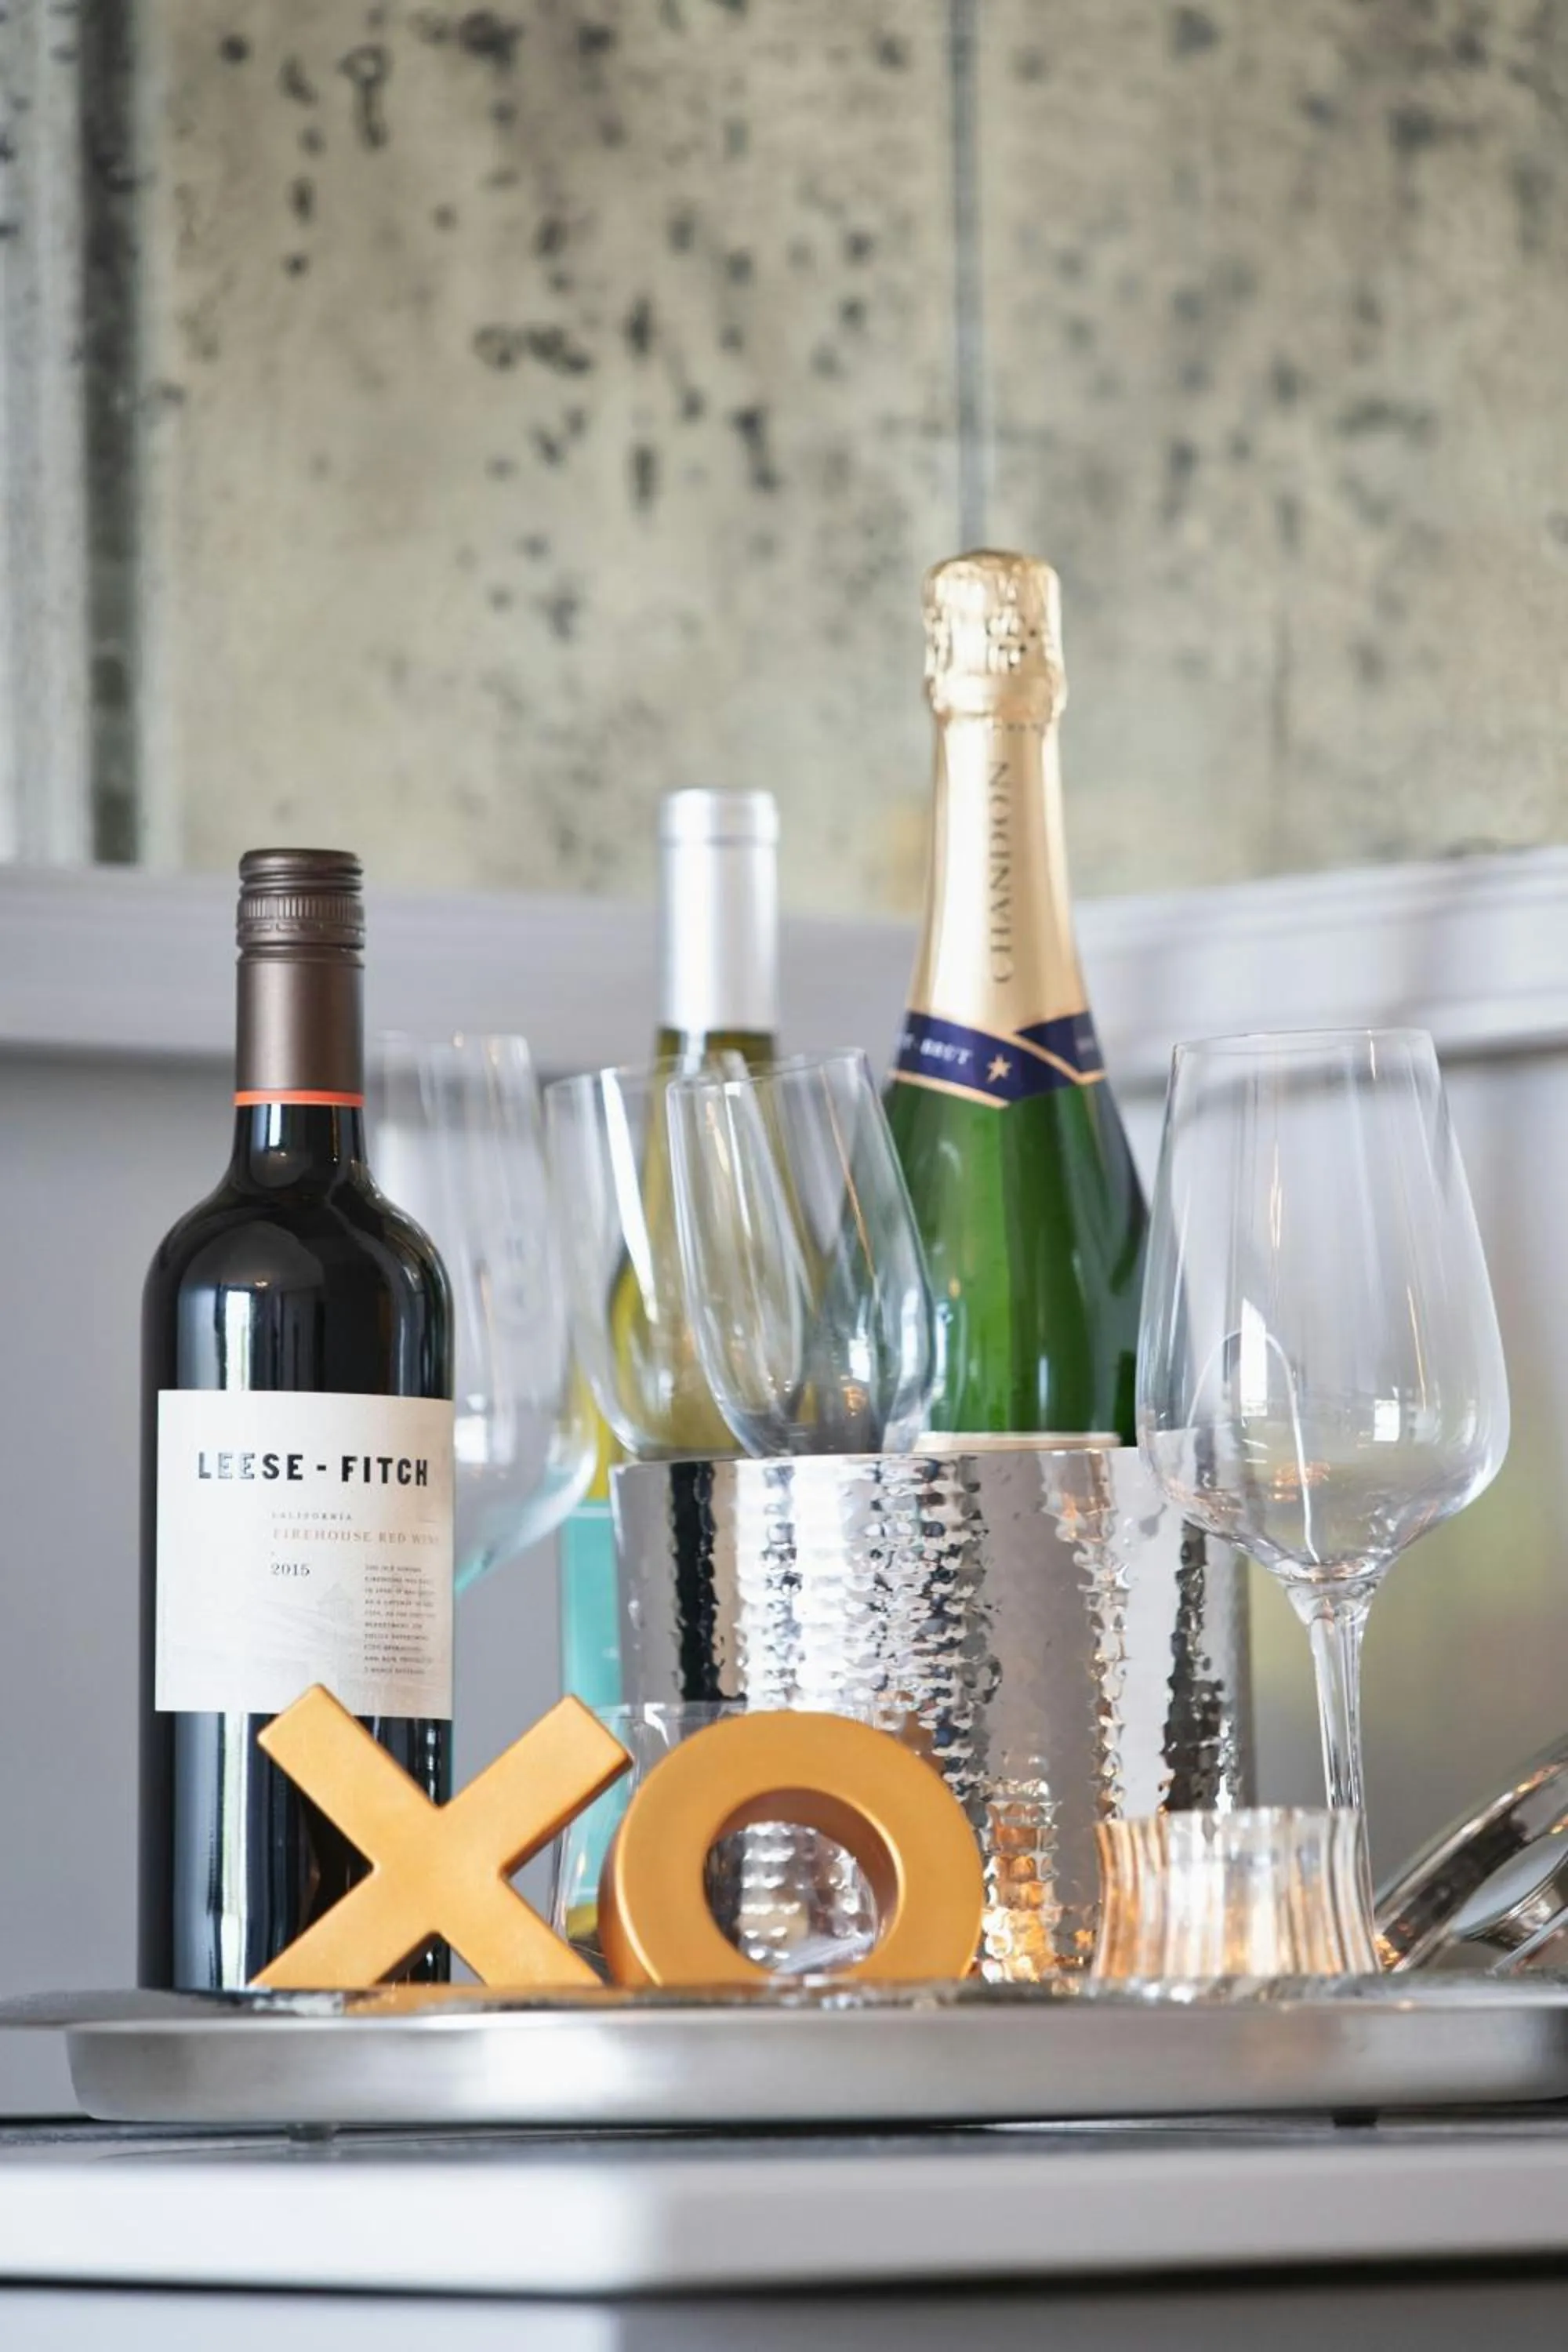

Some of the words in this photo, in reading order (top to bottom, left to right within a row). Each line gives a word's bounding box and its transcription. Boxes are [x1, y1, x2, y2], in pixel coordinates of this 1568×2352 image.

[990, 761, 1013, 985] CHANDON
[920, 1039, 973, 1065] BRUT
[198, 1452, 303, 1480] LEESE
[341, 1456, 428, 1486] FITCH
[273, 1530, 372, 1542] FIREHOUSE
[379, 1532, 407, 1544] RED
[270, 1563, 310, 1577] 2015
